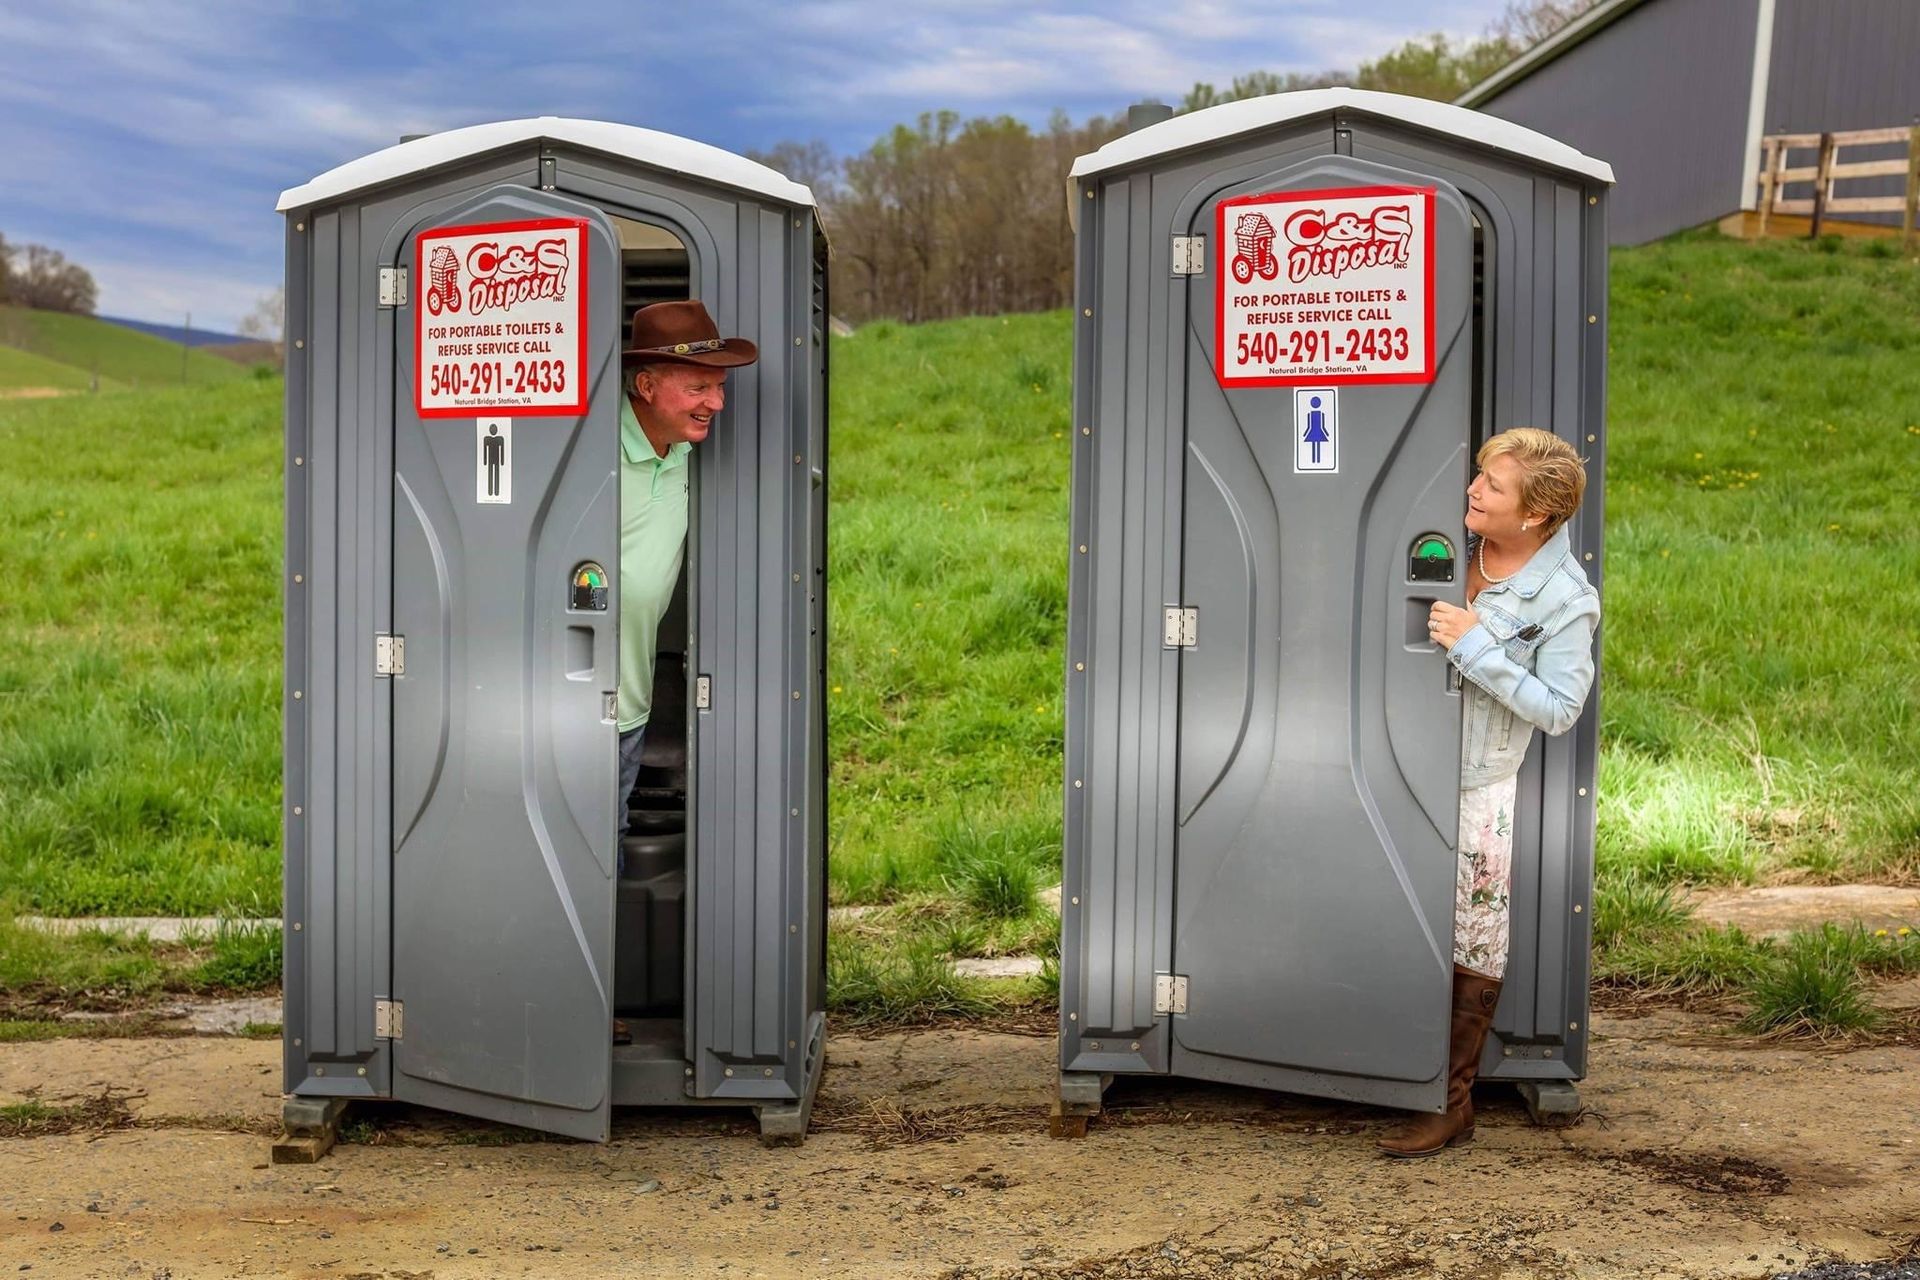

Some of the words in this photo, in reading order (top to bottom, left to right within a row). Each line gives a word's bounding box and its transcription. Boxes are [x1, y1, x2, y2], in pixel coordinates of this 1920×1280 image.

[1284, 205, 1412, 247] C&S
[466, 239, 569, 280] C&S
[1288, 233, 1410, 283] Disposal
[469, 266, 566, 316] Disposal
[1234, 296, 1258, 308] FOR
[1262, 292, 1330, 306] PORTABLE
[1335, 290, 1391, 303] TOILETS
[1396, 289, 1407, 301] &
[1247, 313, 1293, 325] REFUSE
[1298, 310, 1352, 323] SERVICE
[1358, 309, 1392, 321] CALL
[428, 328, 447, 340] FOR
[450, 324, 502, 338] PORTABLE
[506, 322, 551, 336] TOILETS
[555, 322, 564, 334] &
[438, 344, 472, 356] REFUSE
[476, 342, 520, 354] SERVICE
[523, 341, 551, 353] CALL
[1237, 328, 1409, 365] 540-291-2433
[431, 360, 565, 396] 540-291-2433
[1299, 366, 1323, 375] Bridge
[1325, 366, 1354, 374] Station,
[477, 398, 496, 406] Bridge
